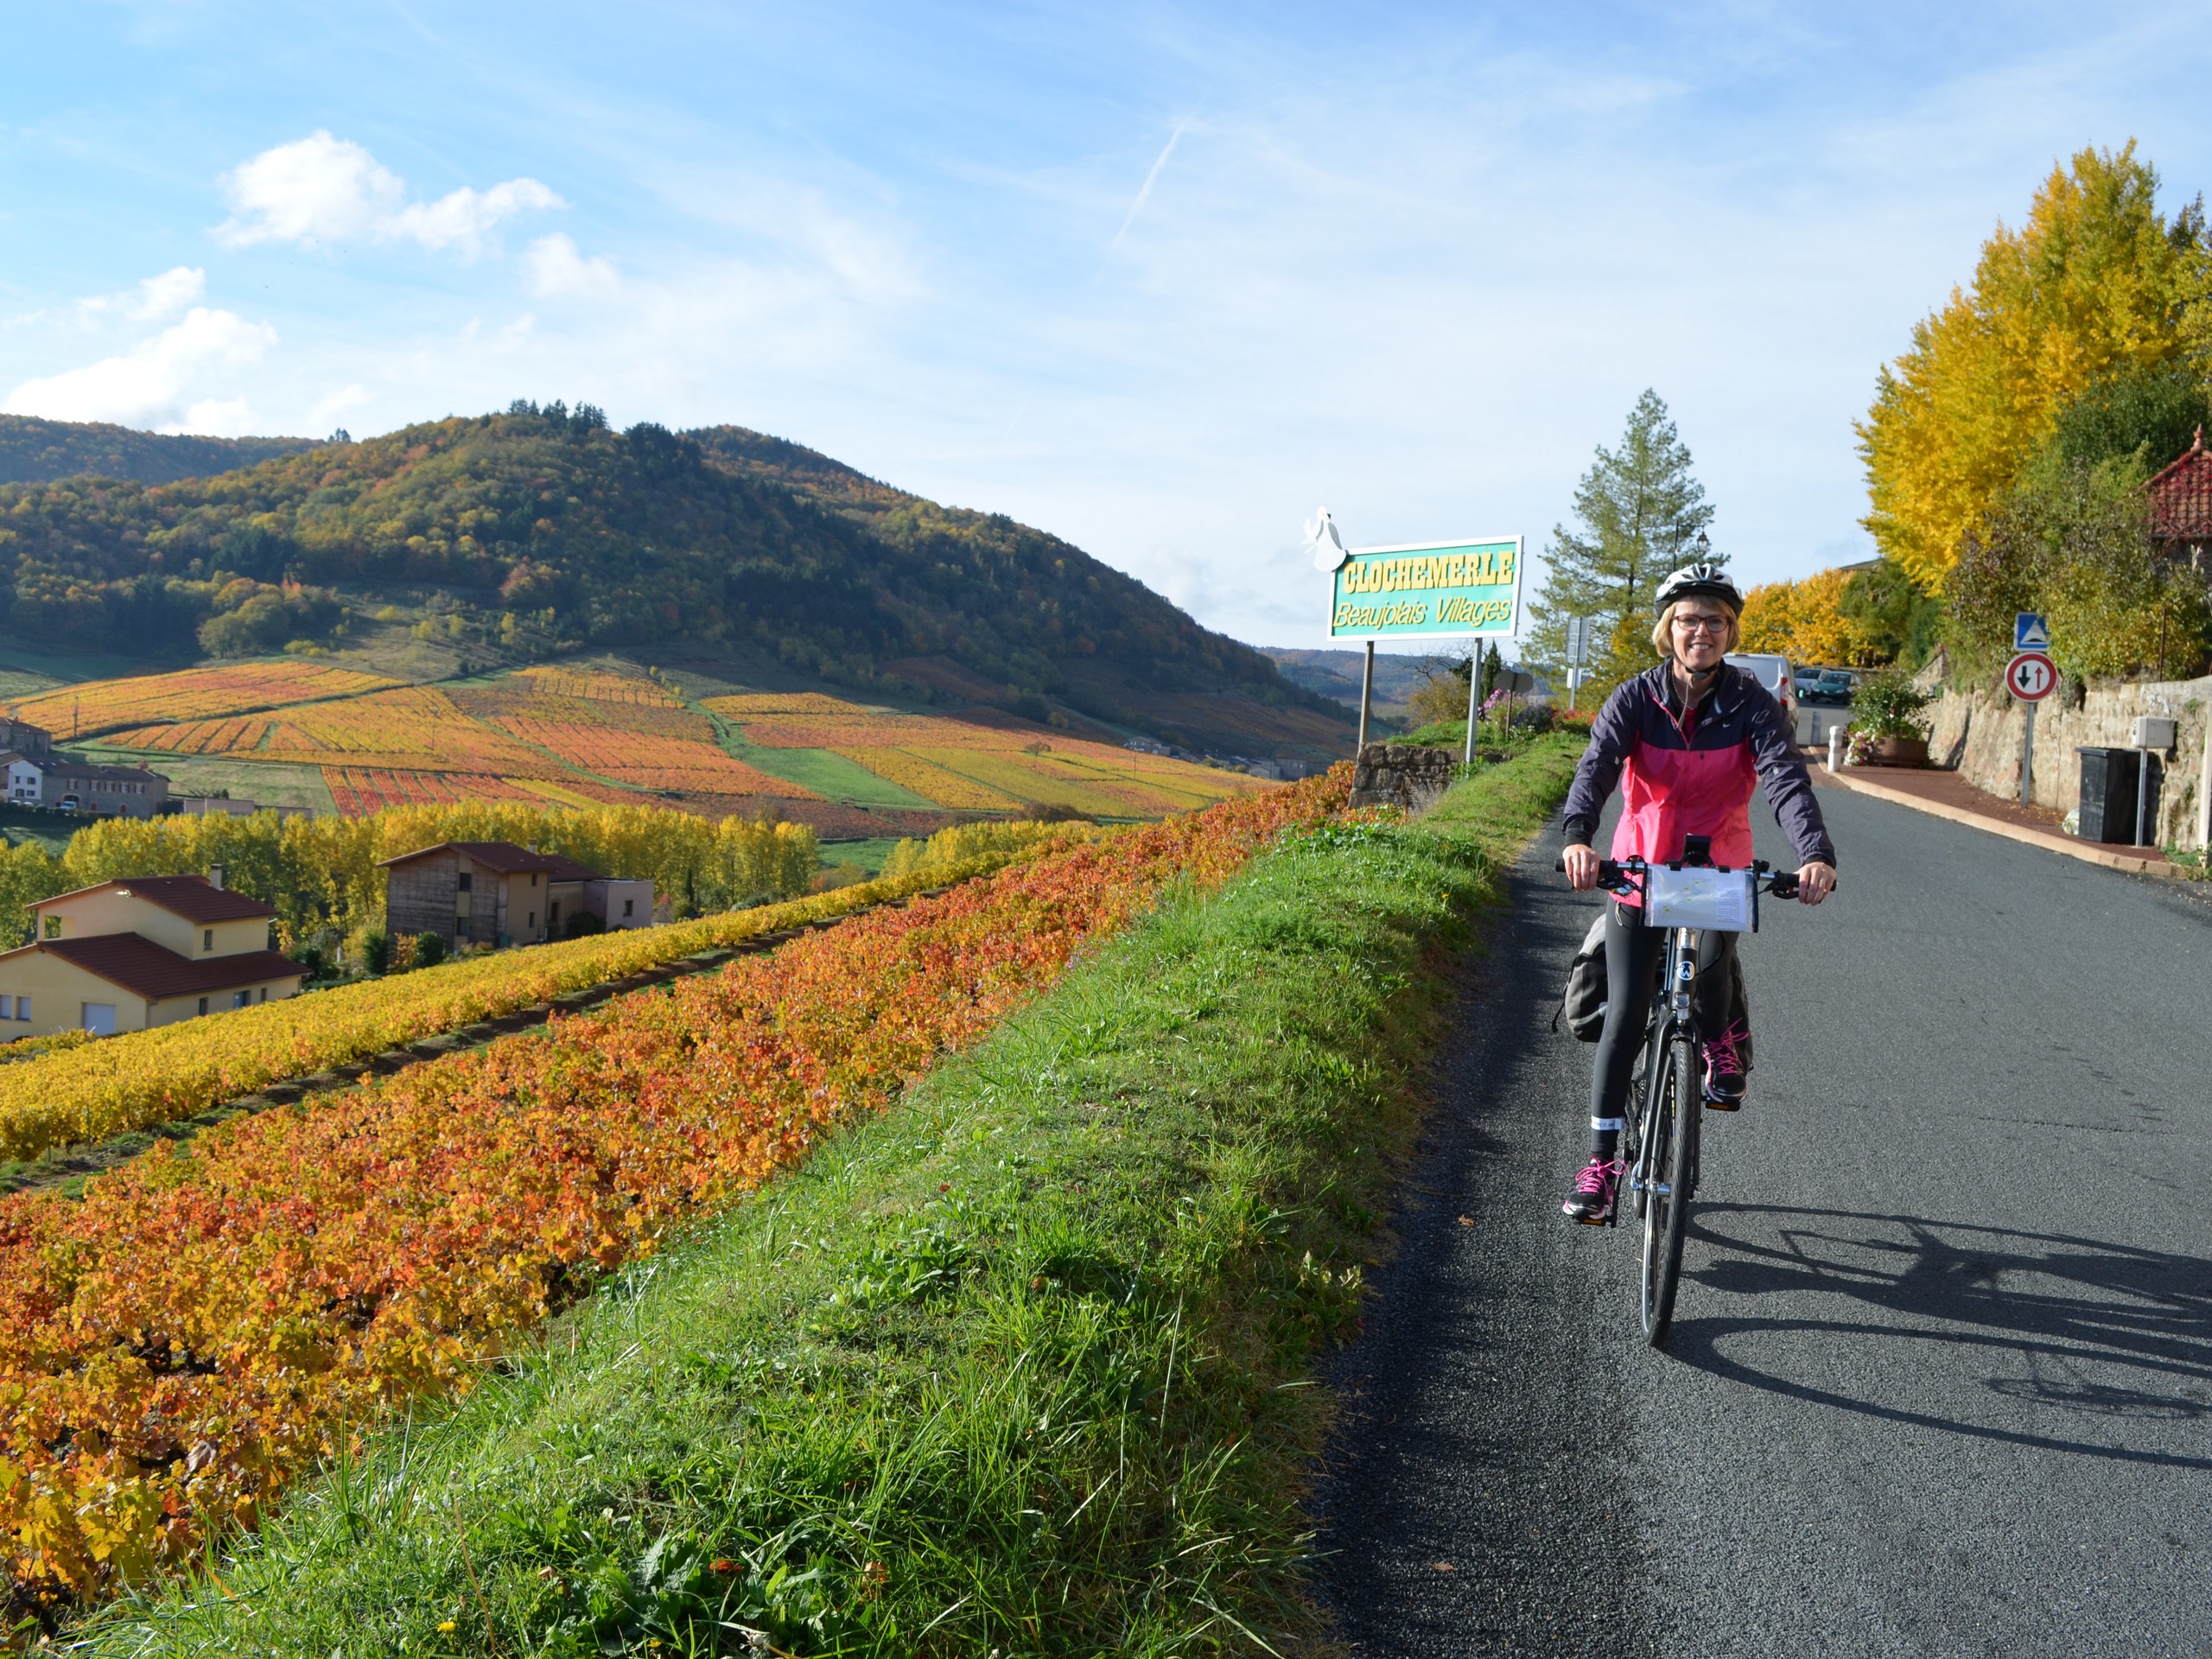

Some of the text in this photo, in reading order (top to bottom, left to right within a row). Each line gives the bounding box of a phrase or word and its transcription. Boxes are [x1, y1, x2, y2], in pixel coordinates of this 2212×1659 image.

[1344, 550, 1514, 594] CLOCHEMERLE
[1333, 596, 1512, 631] Beaujolais Villages
